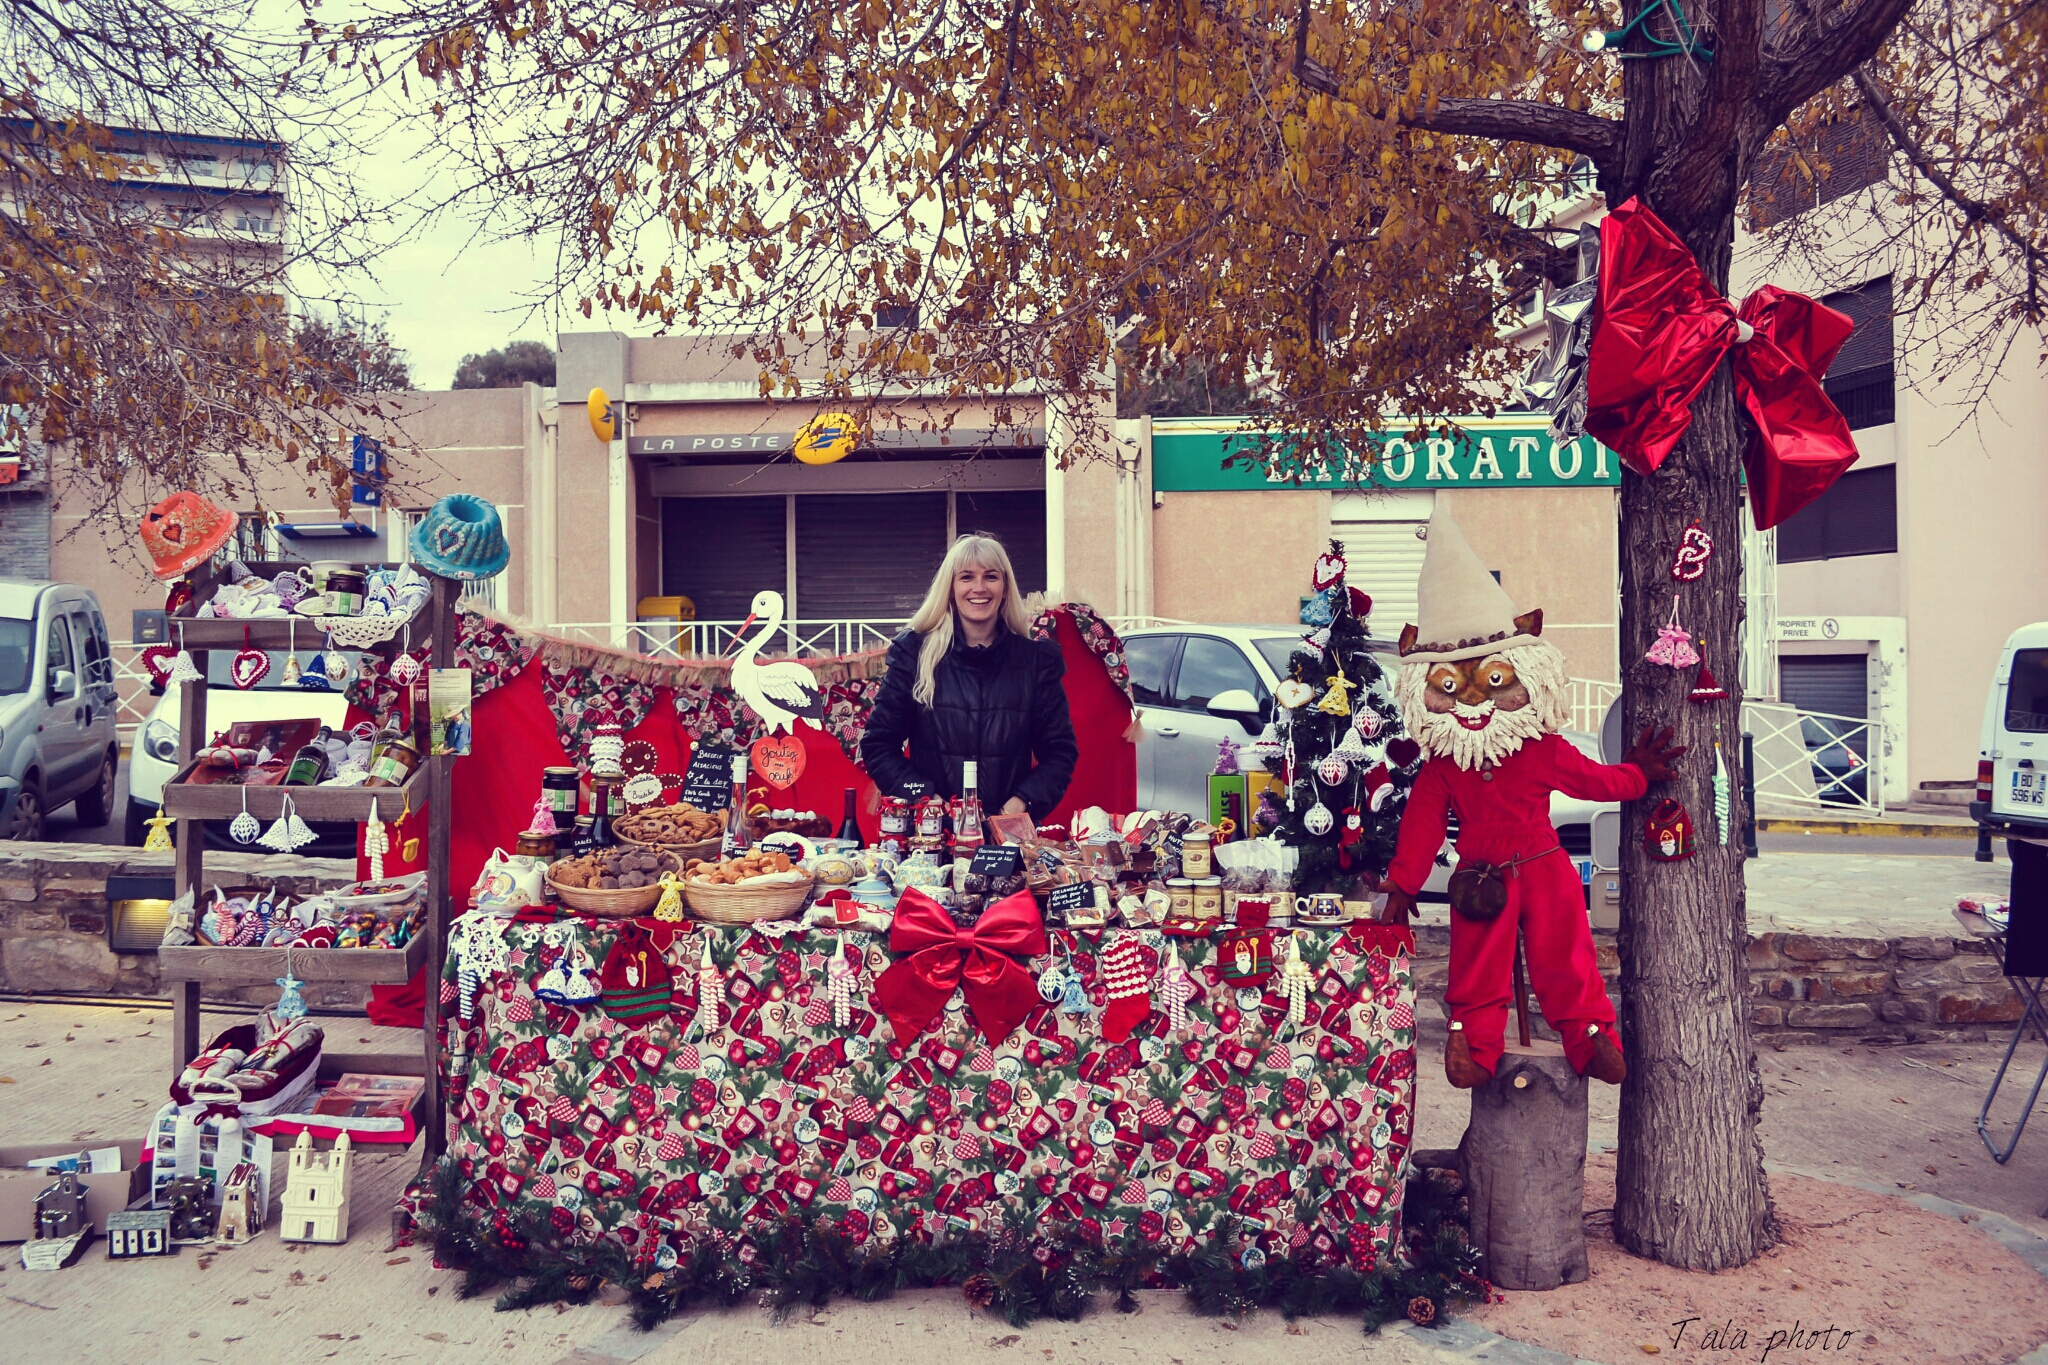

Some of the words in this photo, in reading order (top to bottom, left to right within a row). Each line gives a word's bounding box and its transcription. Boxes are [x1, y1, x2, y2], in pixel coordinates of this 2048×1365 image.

[643, 438, 675, 451] LA
[692, 436, 780, 450] POSTE
[1266, 436, 1621, 482] LABORATOI
[1783, 629, 1809, 637] PRIVEE
[2011, 788, 2044, 805] 596-WS
